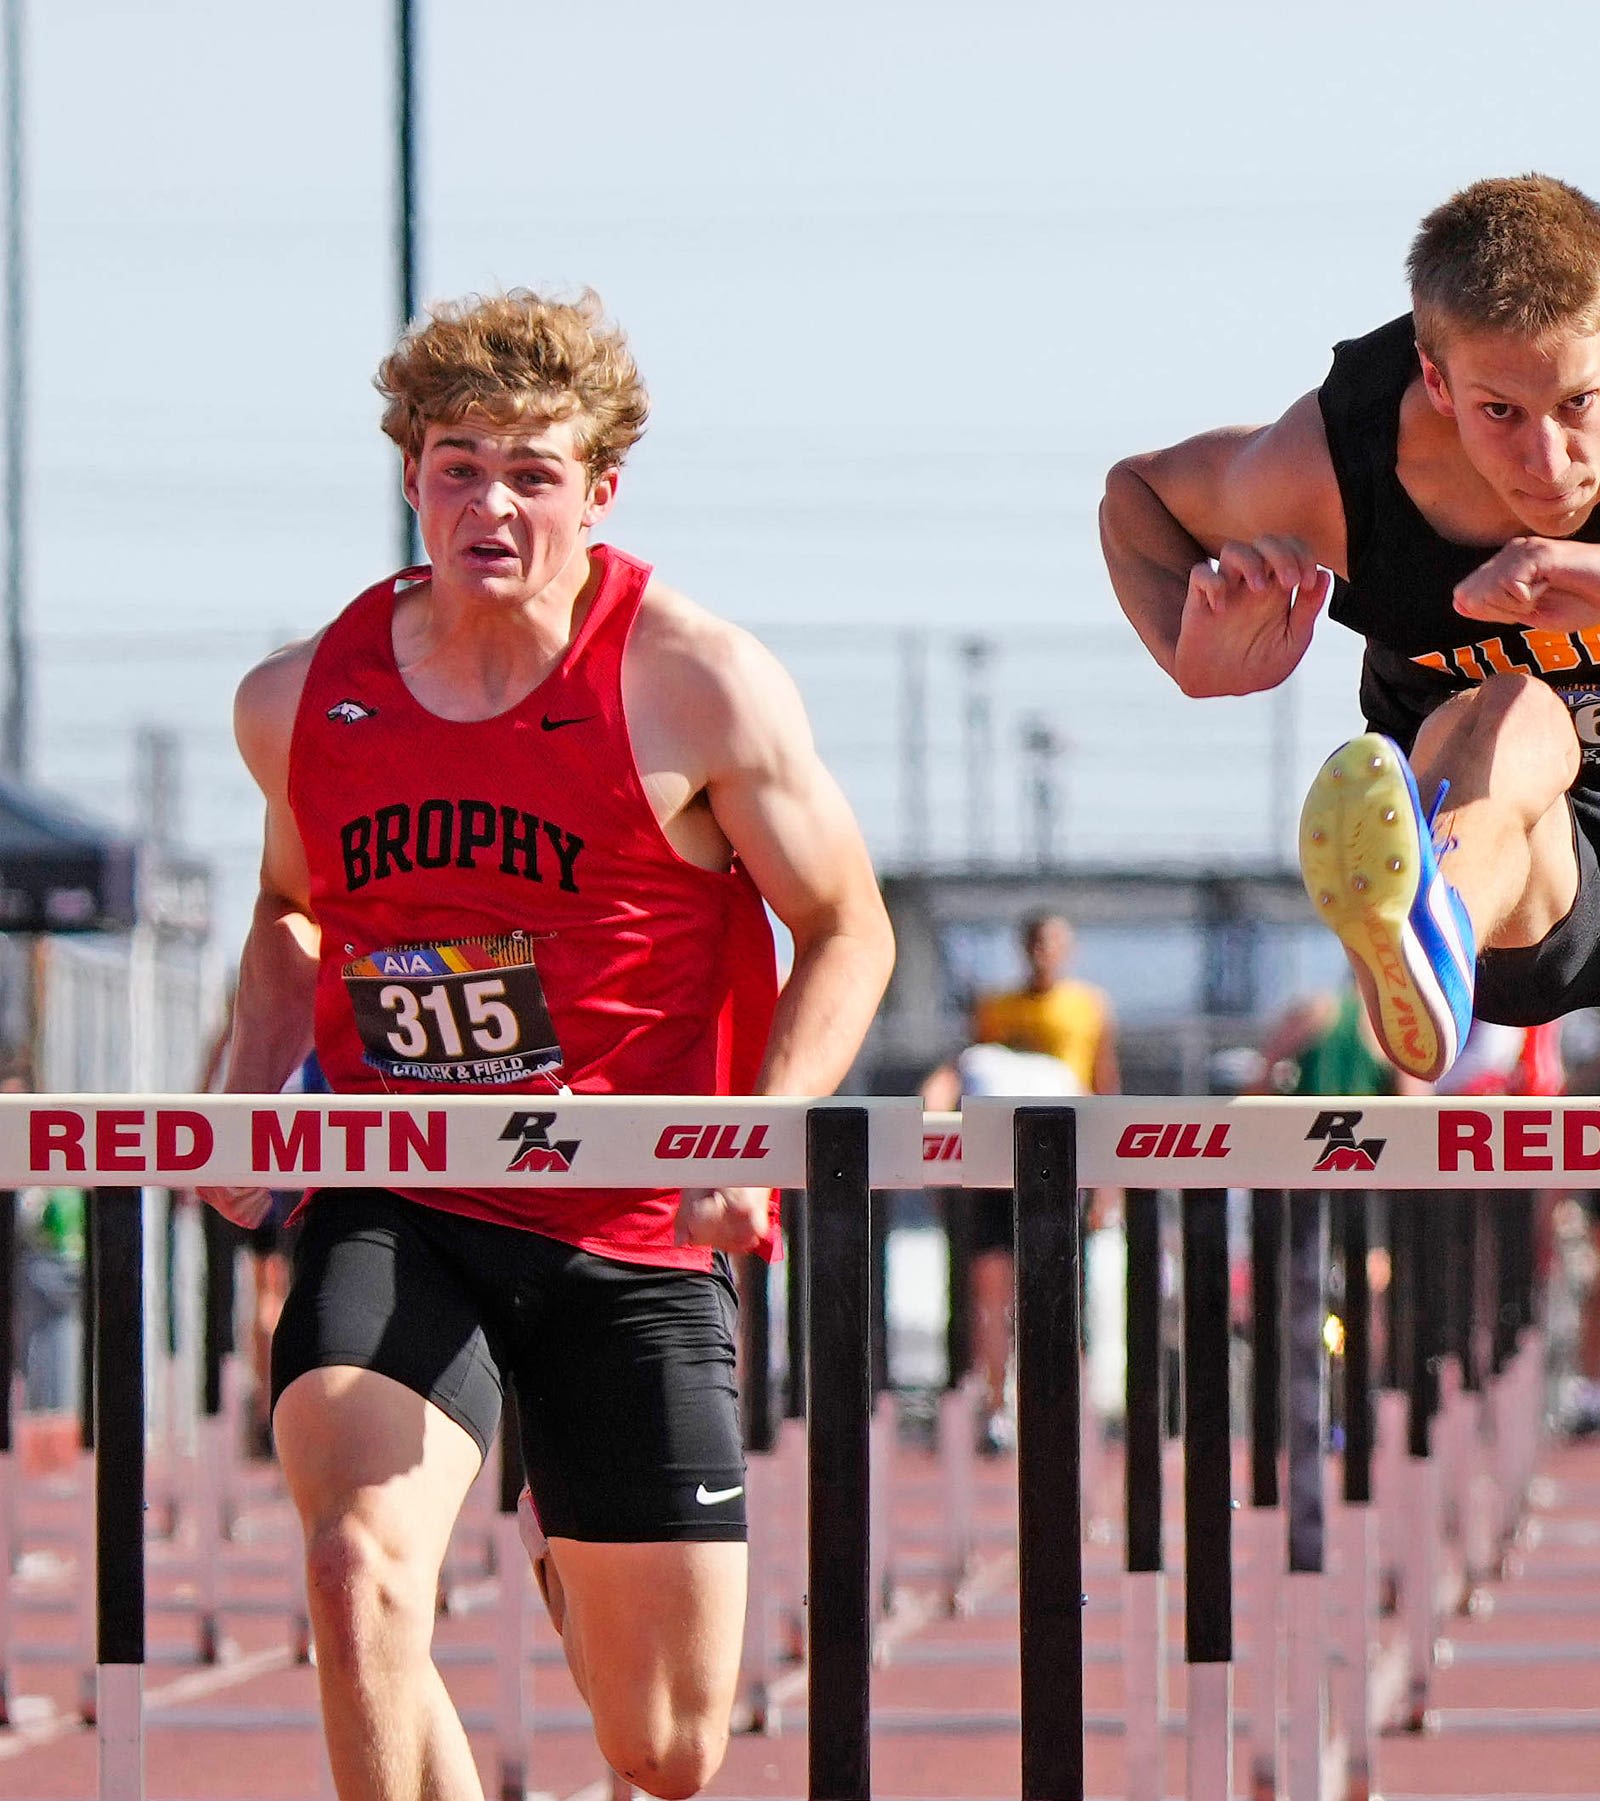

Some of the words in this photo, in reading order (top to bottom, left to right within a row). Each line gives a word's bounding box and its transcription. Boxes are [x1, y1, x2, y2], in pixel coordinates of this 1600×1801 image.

[341, 799, 585, 892] BROPHY
[383, 954, 433, 974] AIA
[379, 979, 520, 1058] 315
[456, 1065, 471, 1079] &
[473, 1057, 524, 1078] FIELD
[28, 1110, 214, 1172] RED
[250, 1110, 448, 1172] MTN
[654, 1124, 771, 1159] GILL
[1116, 1123, 1232, 1159] GILL
